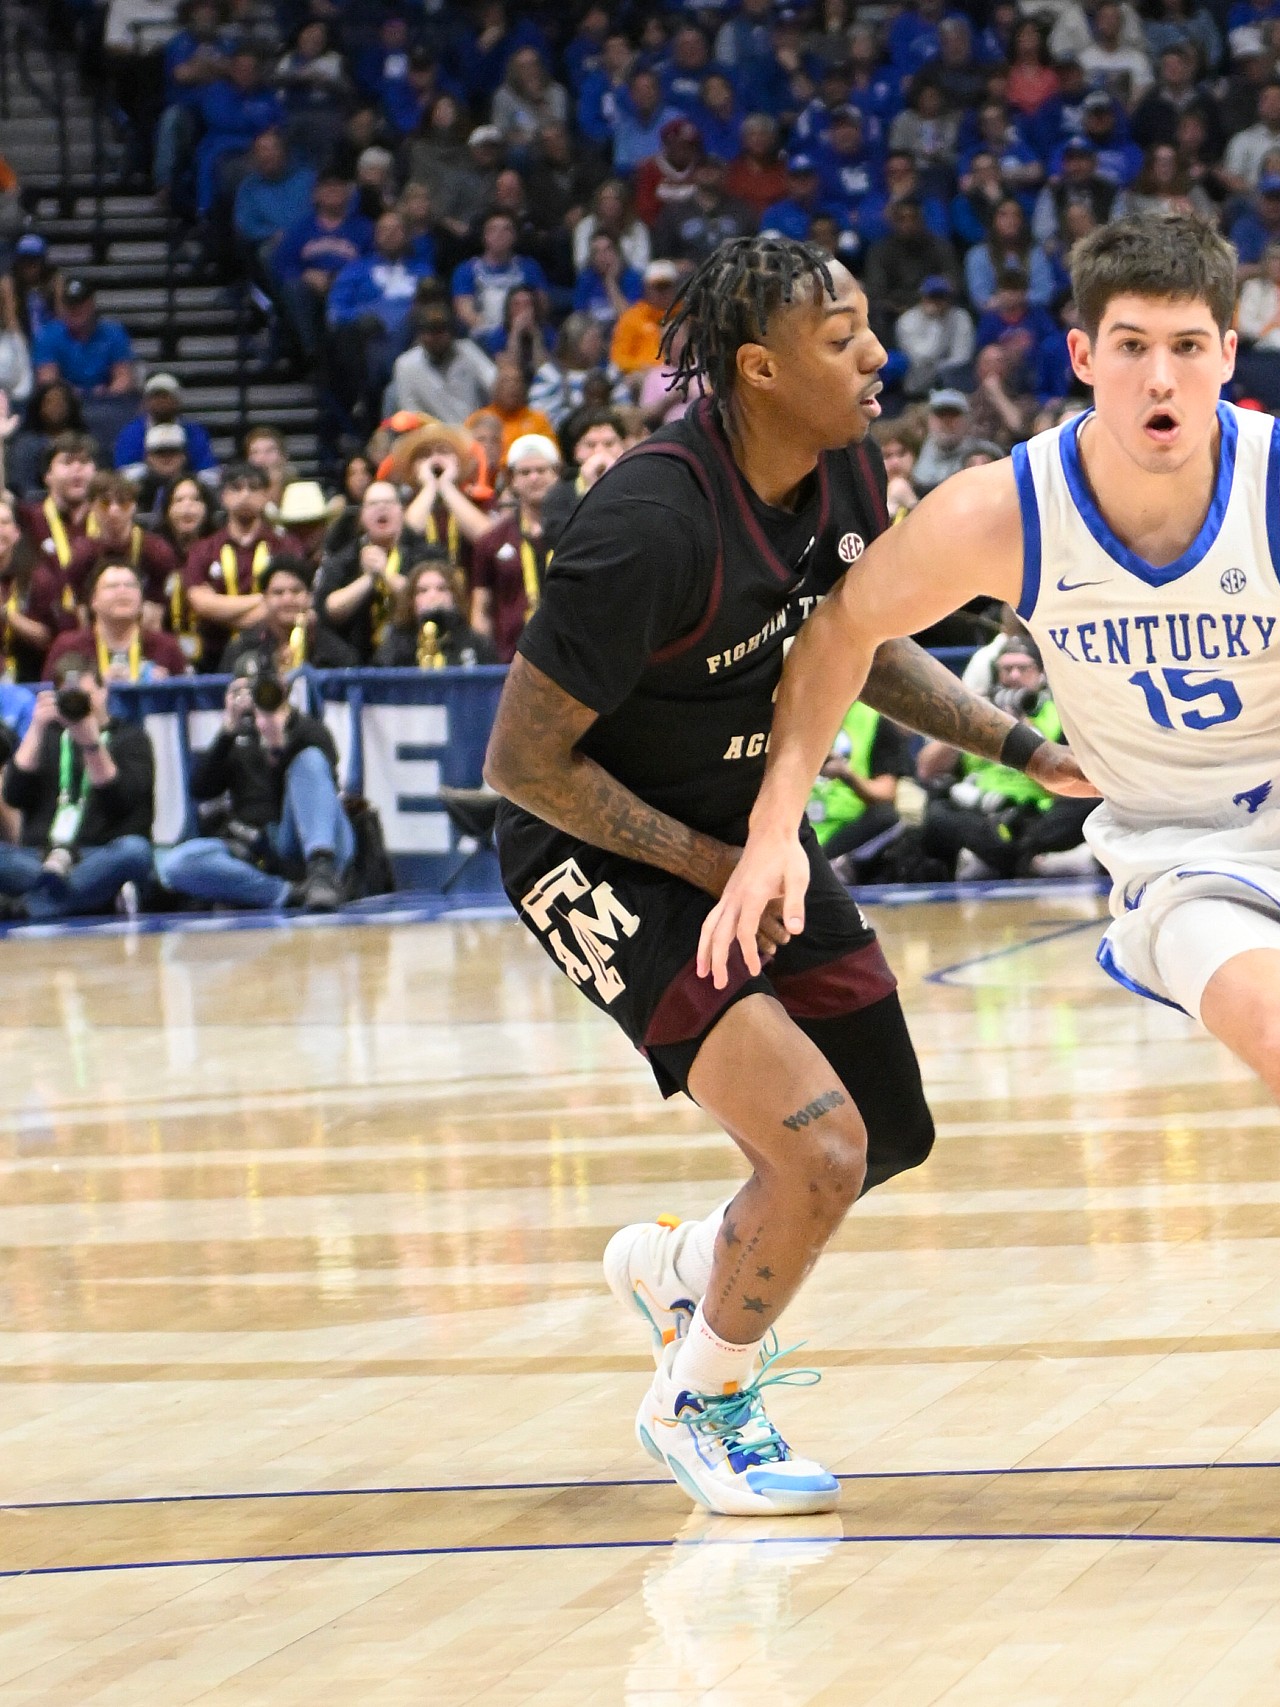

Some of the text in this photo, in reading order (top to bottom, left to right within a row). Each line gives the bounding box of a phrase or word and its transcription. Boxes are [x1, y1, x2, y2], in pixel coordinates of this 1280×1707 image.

[839, 534, 863, 561] SEC
[1221, 568, 1246, 594] SEC
[706, 594, 827, 675] FIGHTIN' T
[1049, 613, 1277, 665] KENTUCKY
[1128, 667, 1243, 731] 15
[722, 732, 771, 760] AG
